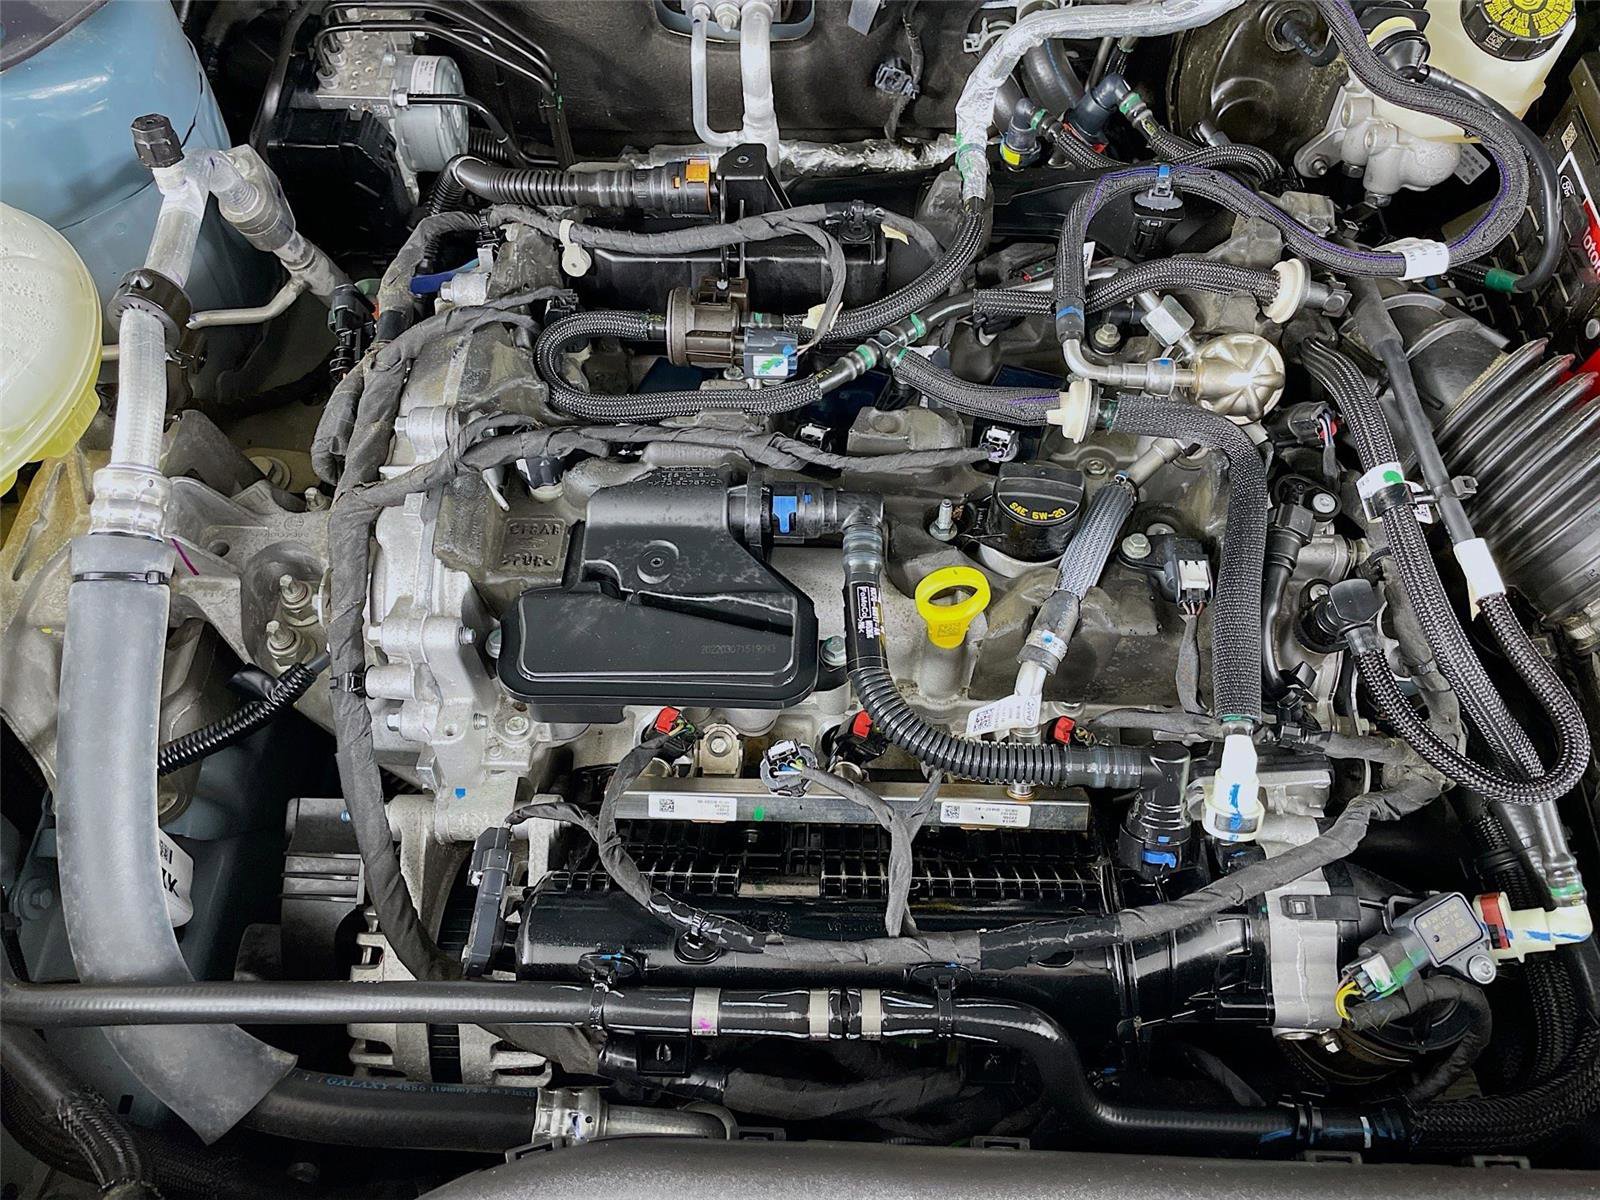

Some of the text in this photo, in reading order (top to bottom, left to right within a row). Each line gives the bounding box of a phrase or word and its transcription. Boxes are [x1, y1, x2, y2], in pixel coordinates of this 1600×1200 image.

[1582, 226, 1600, 279] otor
[1009, 502, 1067, 520] SAE 5W-20
[859, 587, 870, 618] FoMoCo
[327, 1077, 390, 1090] GALAXY
